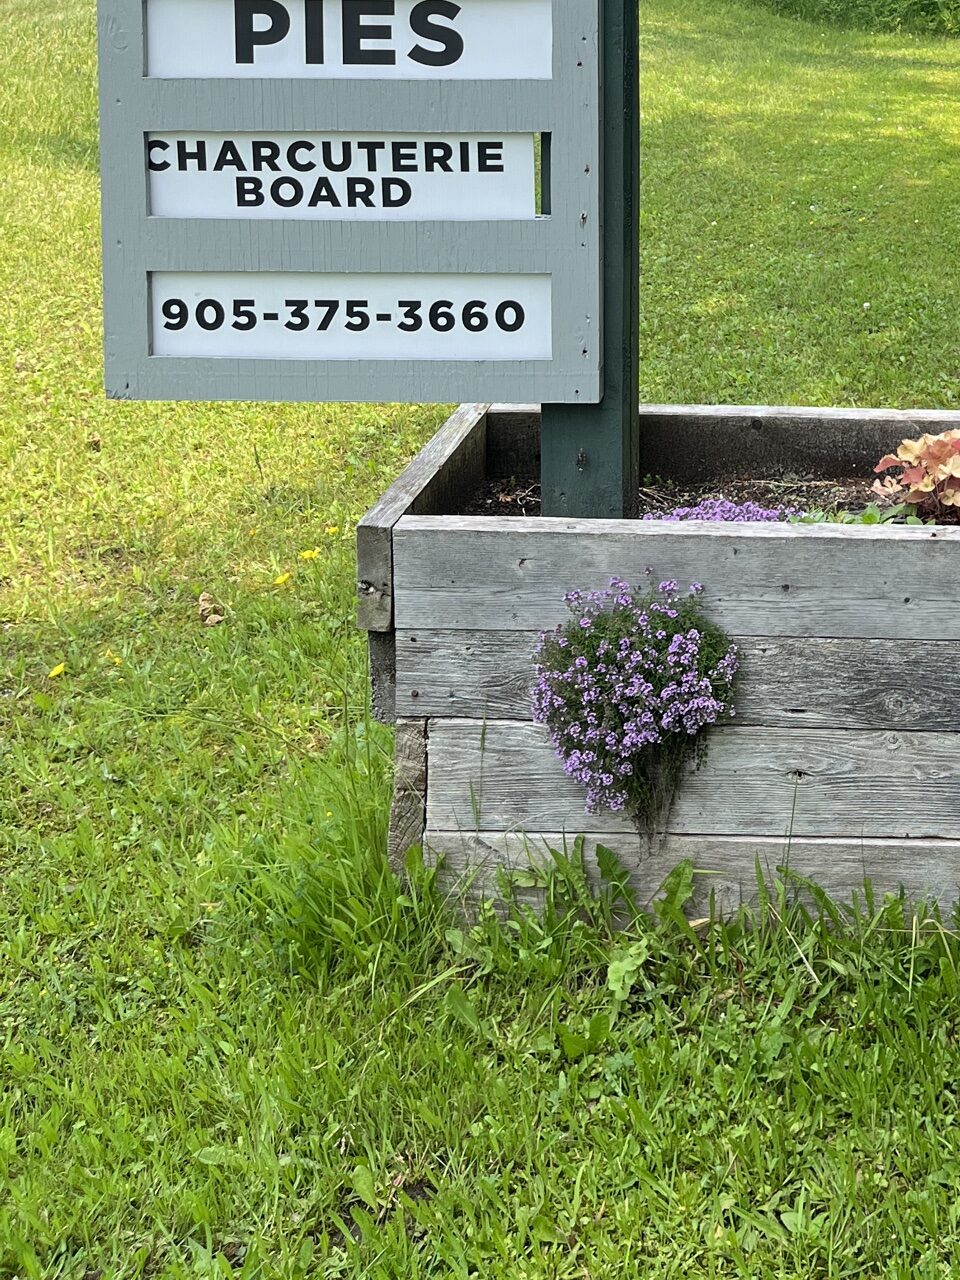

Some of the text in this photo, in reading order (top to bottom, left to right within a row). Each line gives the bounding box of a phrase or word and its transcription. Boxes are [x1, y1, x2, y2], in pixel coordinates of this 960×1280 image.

[148, 140, 504, 173] CHARCUTERIE
[236, 176, 411, 207] BOARD
[162, 299, 524, 332] 905-375-3660
